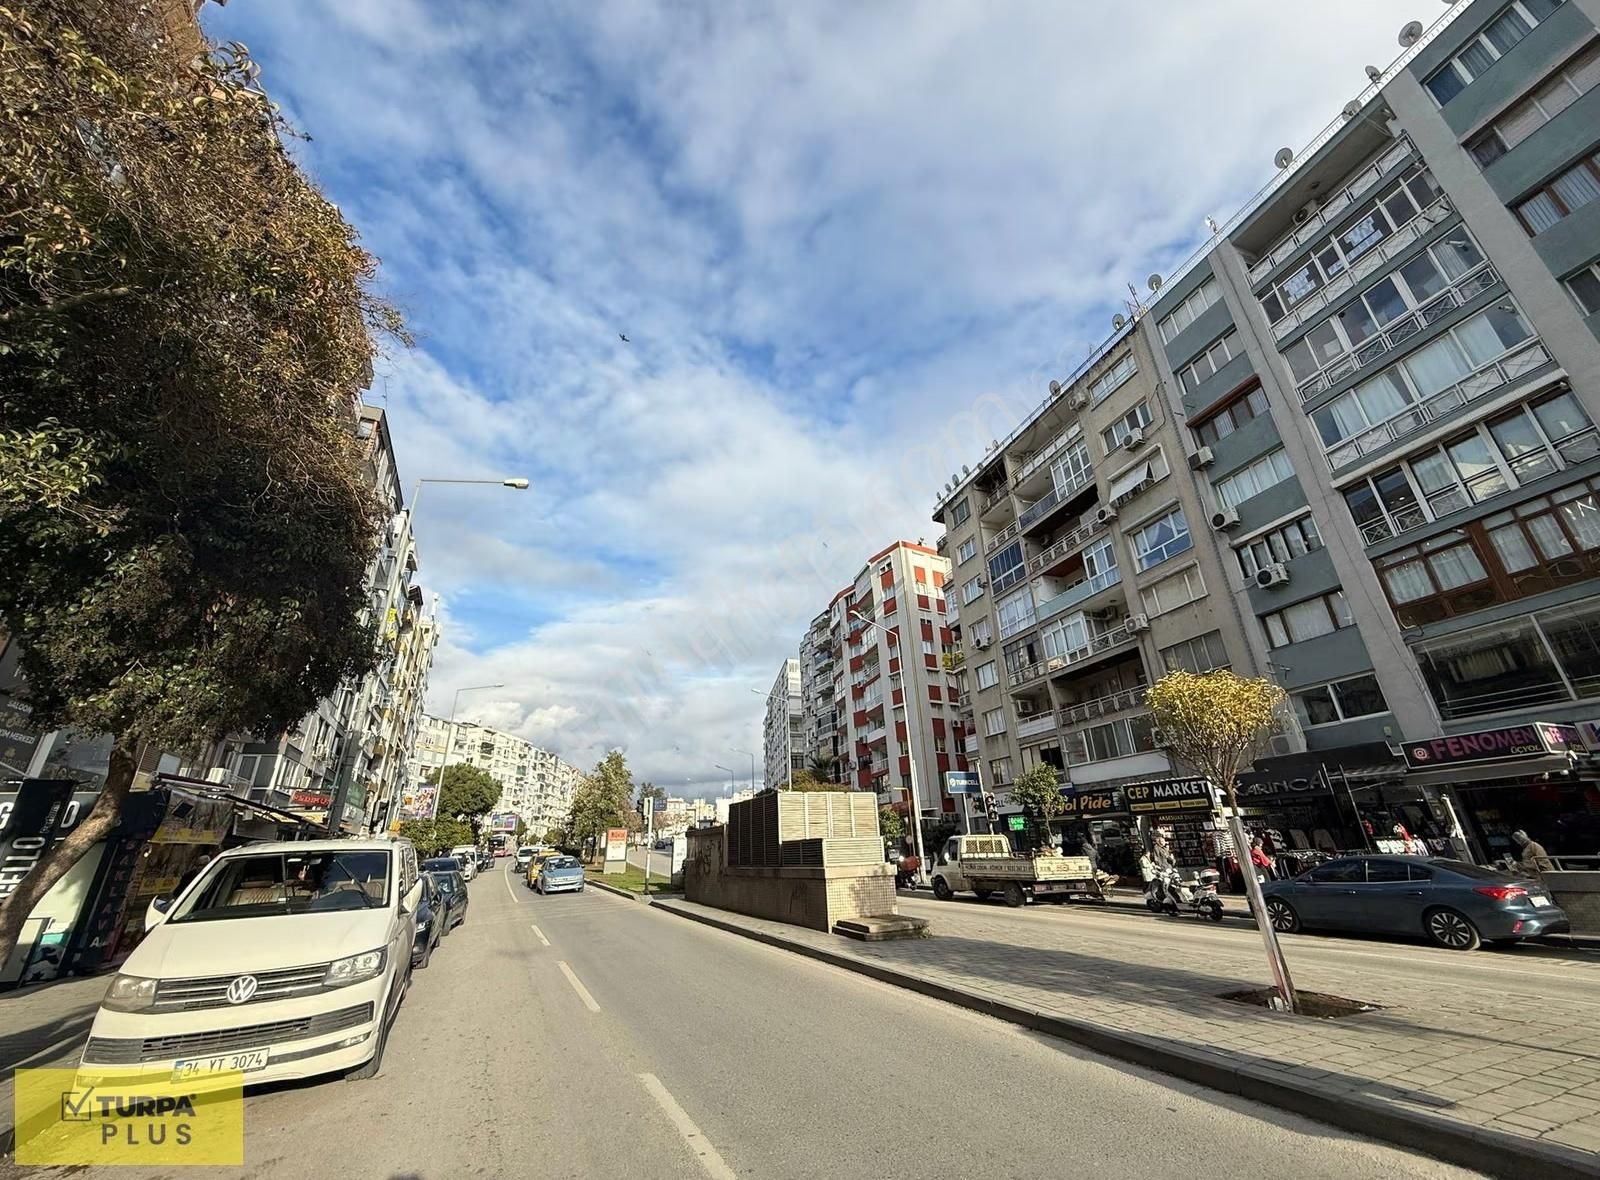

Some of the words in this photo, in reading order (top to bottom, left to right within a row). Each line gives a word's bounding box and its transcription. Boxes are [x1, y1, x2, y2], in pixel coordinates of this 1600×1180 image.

[1430, 727, 1537, 761] FENOMEN
[1127, 786, 1150, 800] CEP
[1153, 780, 1207, 798] MARKET
[1080, 795, 1112, 810] Pide
[183, 1062, 200, 1077] 34
[209, 1058, 226, 1072] YT
[230, 1053, 263, 1070] 3074
